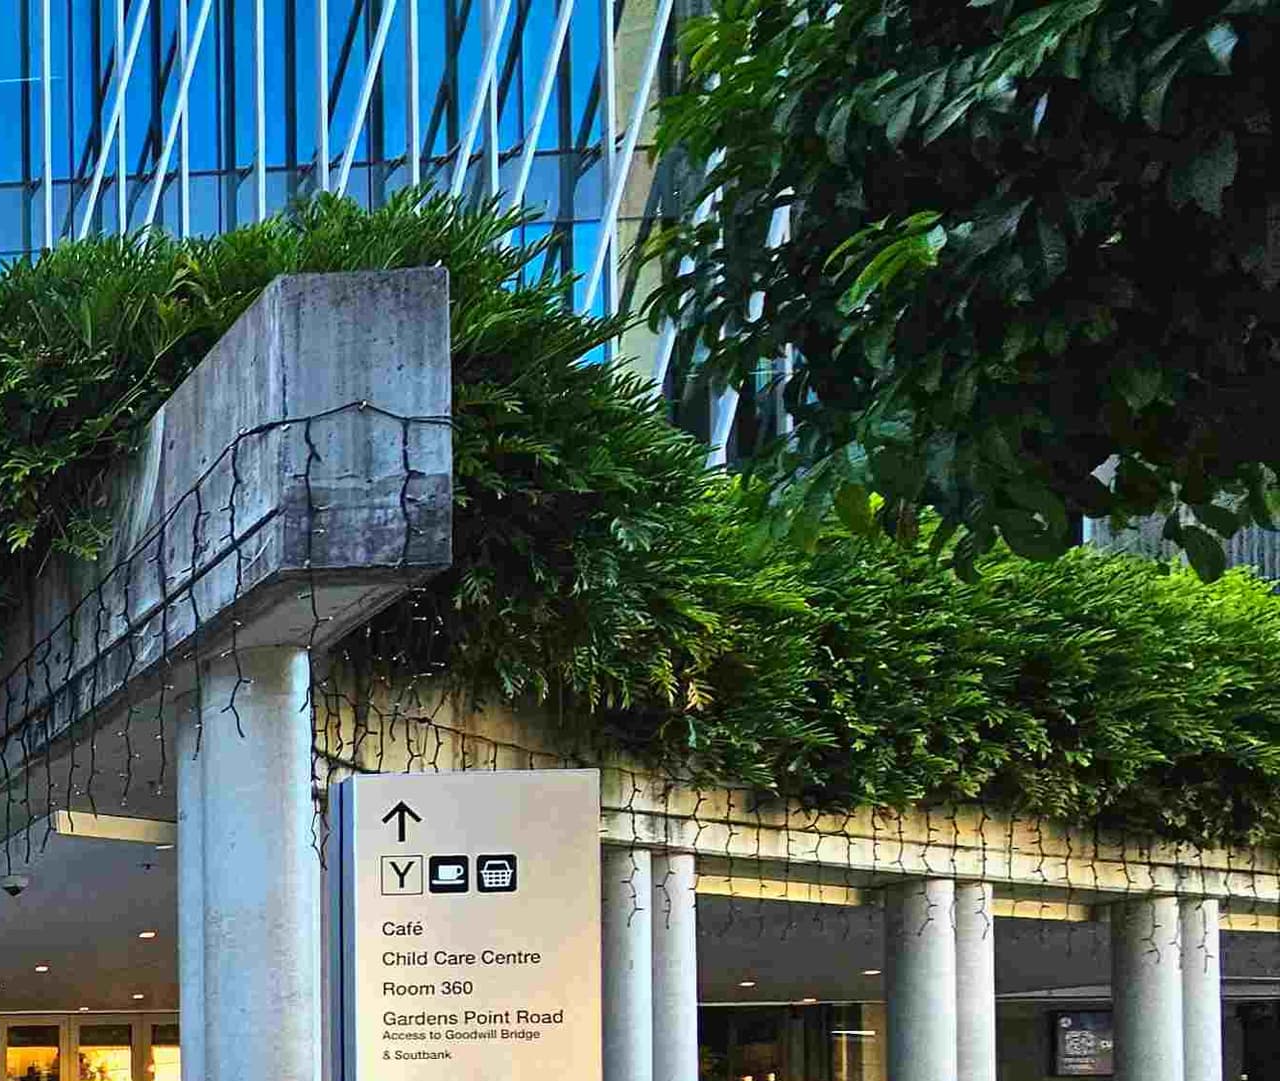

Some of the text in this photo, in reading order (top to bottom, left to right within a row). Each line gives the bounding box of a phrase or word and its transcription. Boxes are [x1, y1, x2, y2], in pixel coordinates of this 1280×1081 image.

[389, 861, 415, 889] Y
[382, 920, 424, 936] Café
[382, 950, 541, 966] Child Care Centre
[383, 981, 473, 996] Room 360
[383, 1009, 564, 1026] Gardens Point Road
[382, 1029, 541, 1041] Access to Goodwill Bridge
[382, 1050, 391, 1060] &
